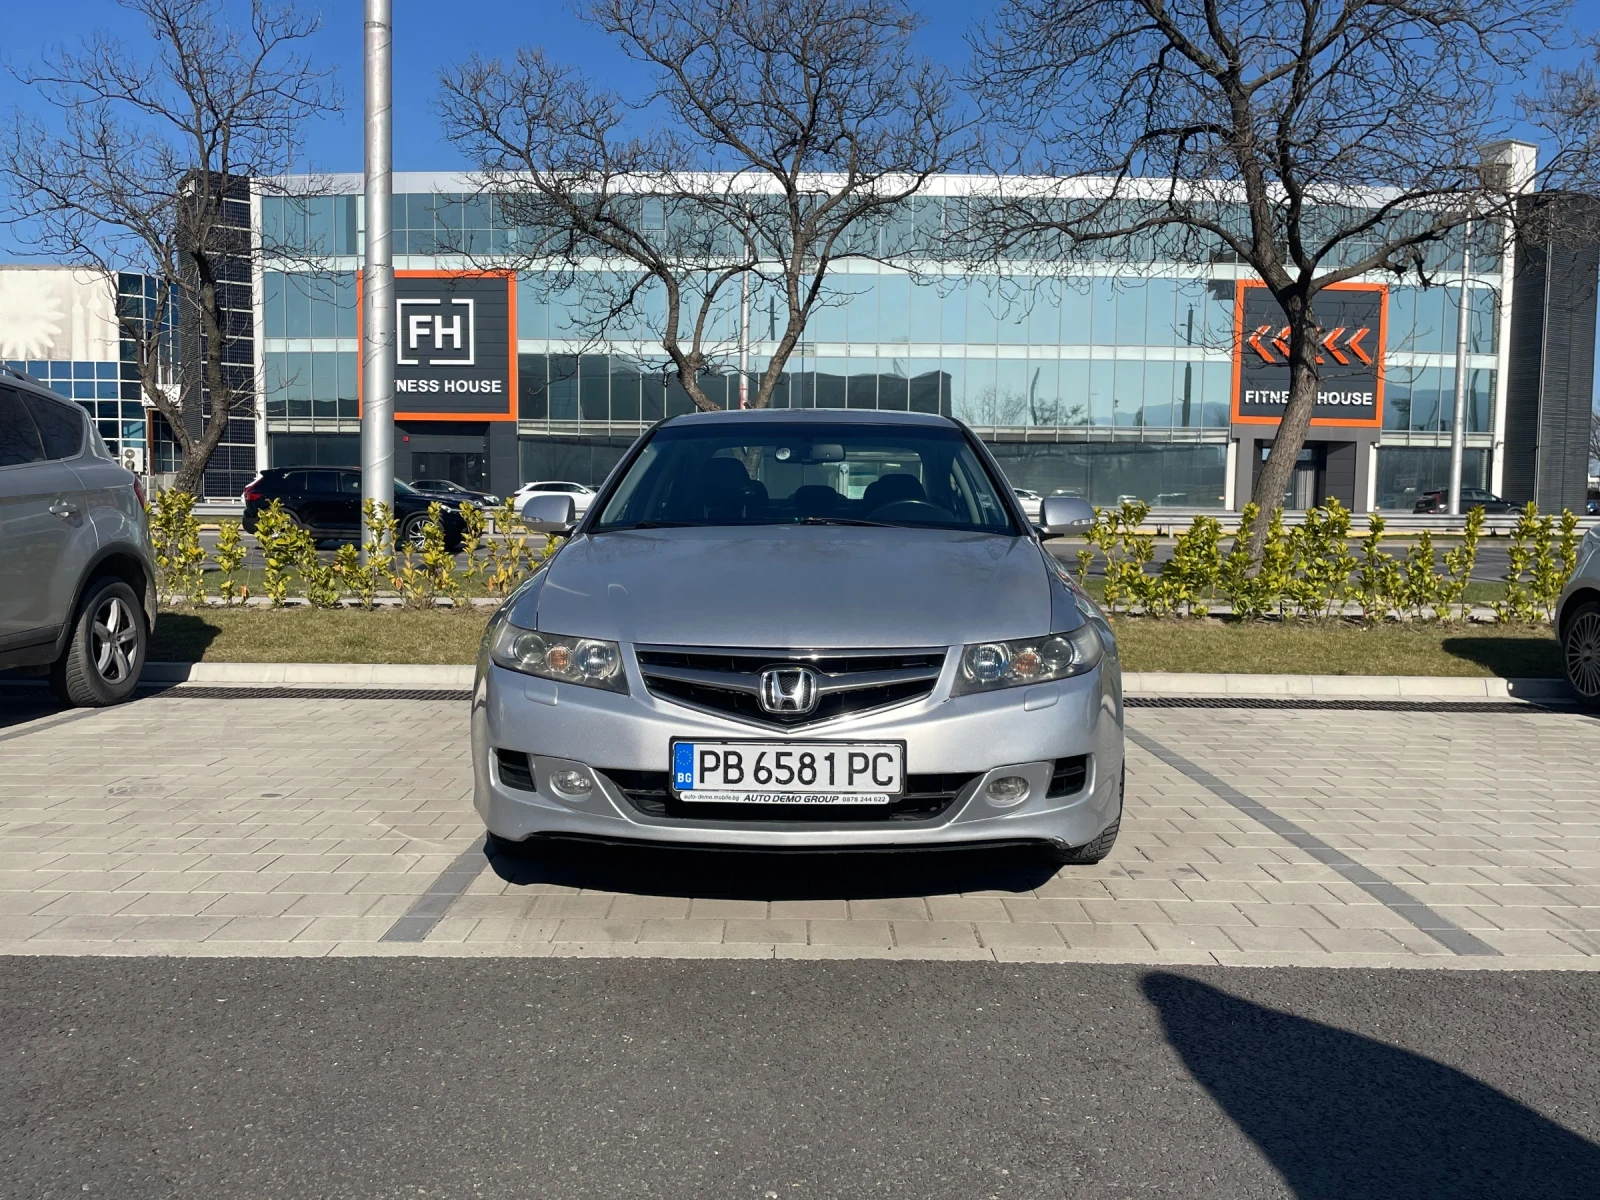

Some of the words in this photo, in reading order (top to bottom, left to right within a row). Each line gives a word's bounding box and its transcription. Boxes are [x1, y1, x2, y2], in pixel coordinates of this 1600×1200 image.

[409, 315, 461, 349] FH
[394, 379, 439, 392] NESS
[444, 380, 502, 393] HOUSE
[1245, 390, 1290, 404] FITNE
[1317, 392, 1373, 406] HOUSE
[699, 750, 745, 785] PB
[753, 751, 835, 786] 6581
[847, 752, 894, 786] PC
[677, 772, 692, 783] BG
[743, 794, 771, 802] AUTO
[772, 795, 802, 803] DEMO
[803, 795, 839, 803] GROUP
